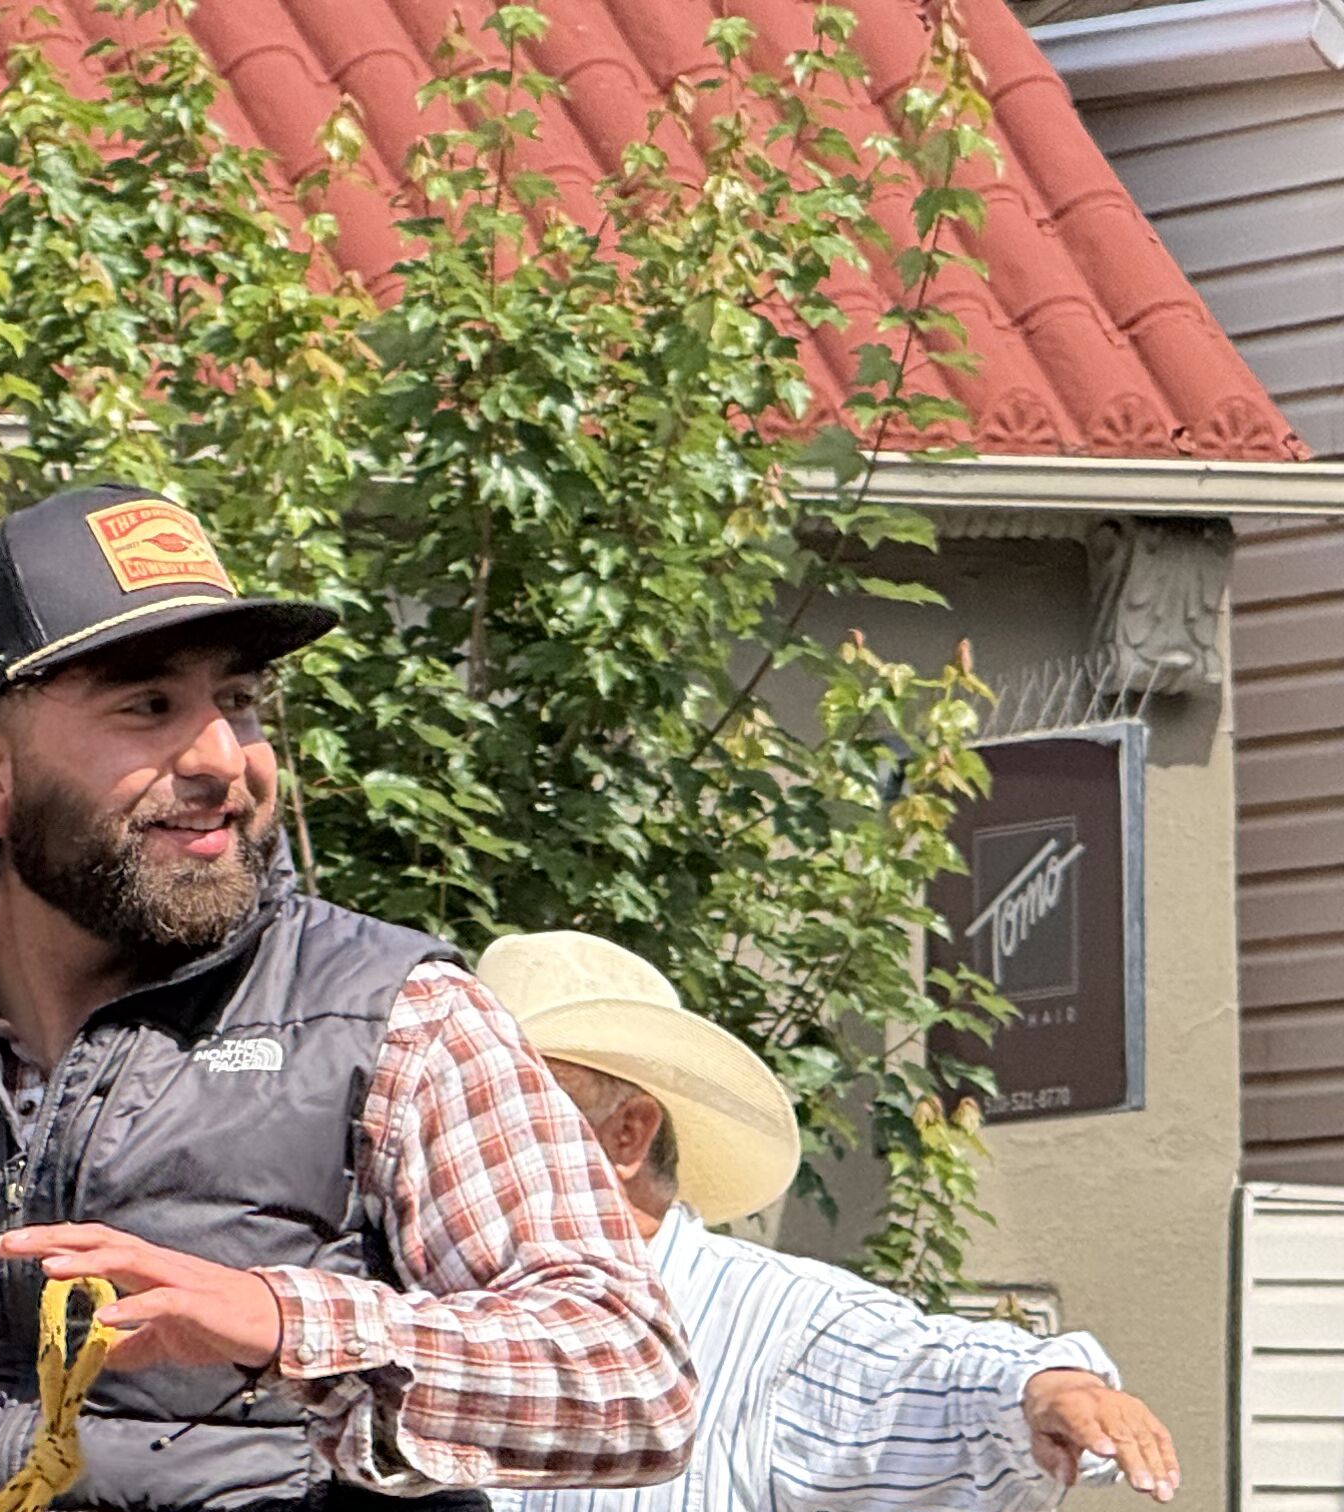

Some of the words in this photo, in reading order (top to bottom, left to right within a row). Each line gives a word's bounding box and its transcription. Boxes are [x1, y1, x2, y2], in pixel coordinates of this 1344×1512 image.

[105, 511, 138, 537] THE
[964, 838, 1085, 986] Tomo
[223, 1040, 259, 1051] THE
[193, 1049, 255, 1062] NORTH
[208, 1060, 257, 1073] FACE
